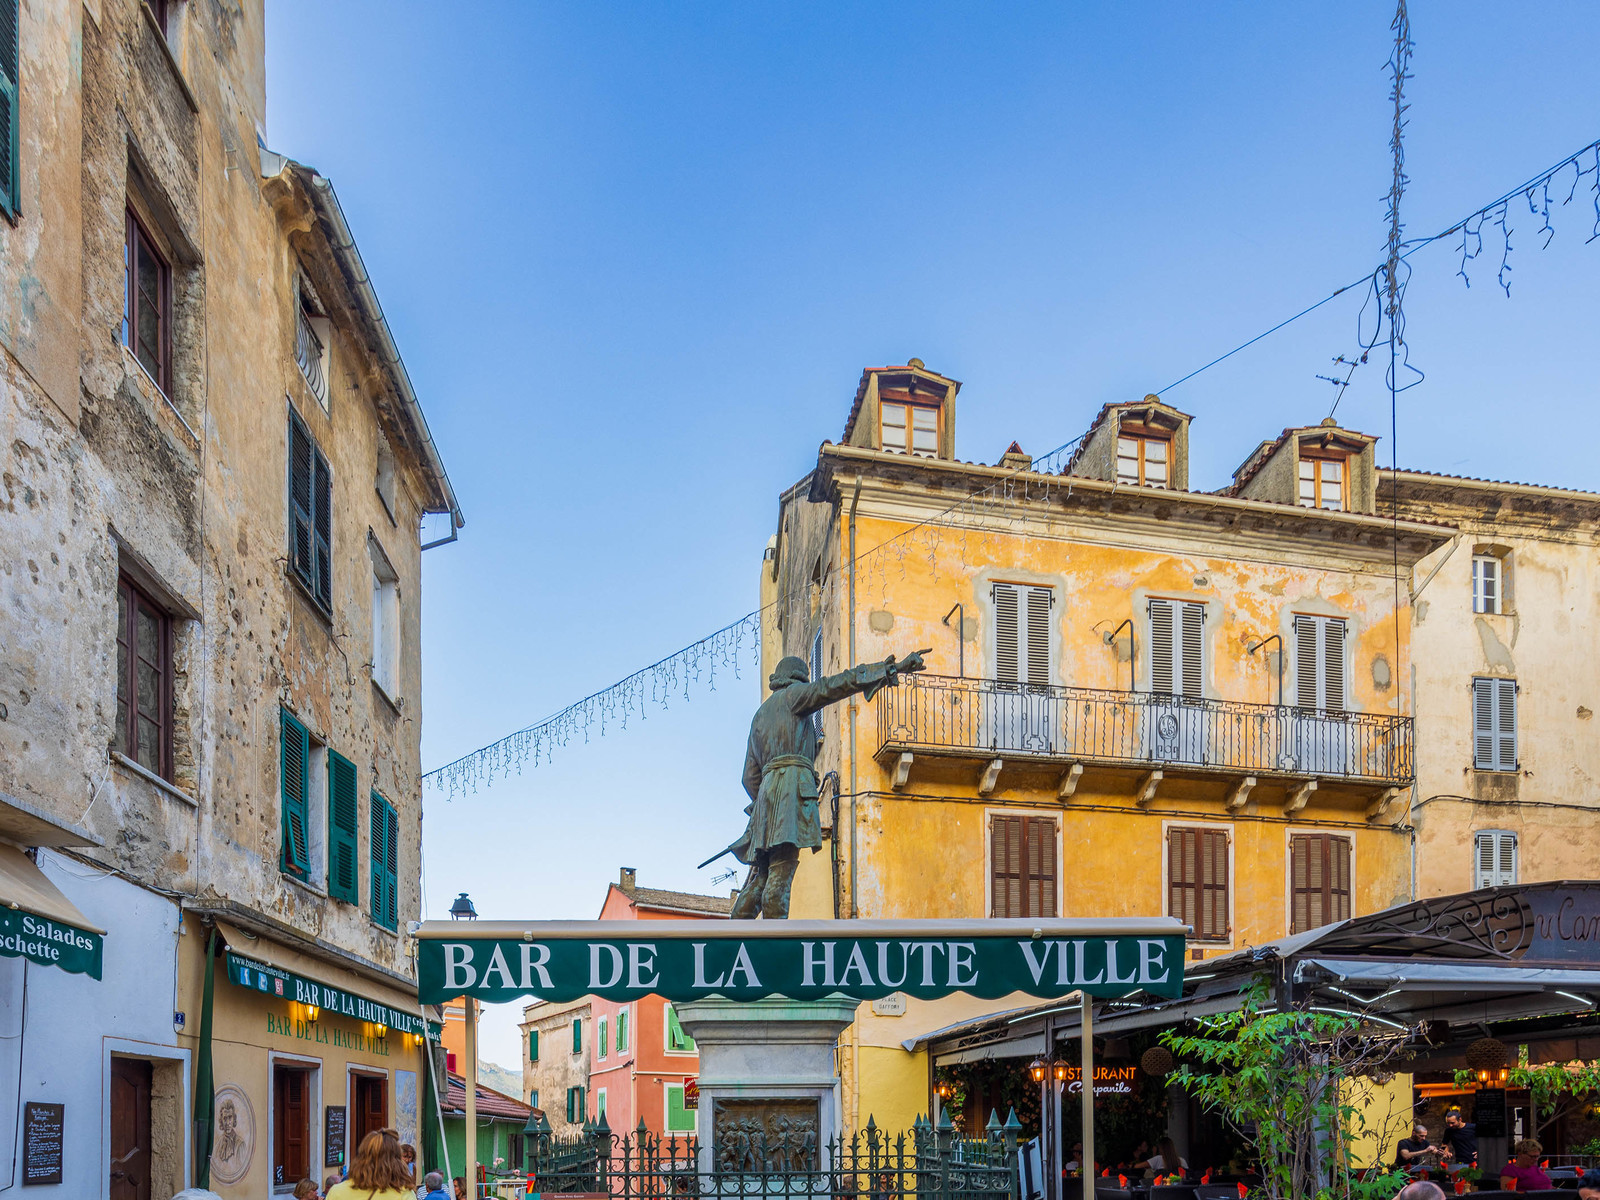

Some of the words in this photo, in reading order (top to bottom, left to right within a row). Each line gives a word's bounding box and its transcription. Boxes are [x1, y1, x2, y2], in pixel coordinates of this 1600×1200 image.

[23, 916, 94, 951] Salades
[442, 942, 555, 989] BAR
[587, 942, 660, 988] DE
[691, 942, 763, 988] LA
[800, 940, 979, 987] HAUTE
[1017, 939, 1170, 986] VILLE
[295, 979, 320, 1006] BAR
[323, 987, 338, 1011] DE
[341, 993, 355, 1016] LA
[358, 998, 388, 1025] HAUTE
[389, 1008, 412, 1033] VILLE
[267, 1012, 292, 1037] BAR
[296, 1019, 312, 1040] DE
[315, 1023, 329, 1044] LA
[333, 1028, 365, 1052] HAUTE
[366, 1036, 390, 1057] VILLE
